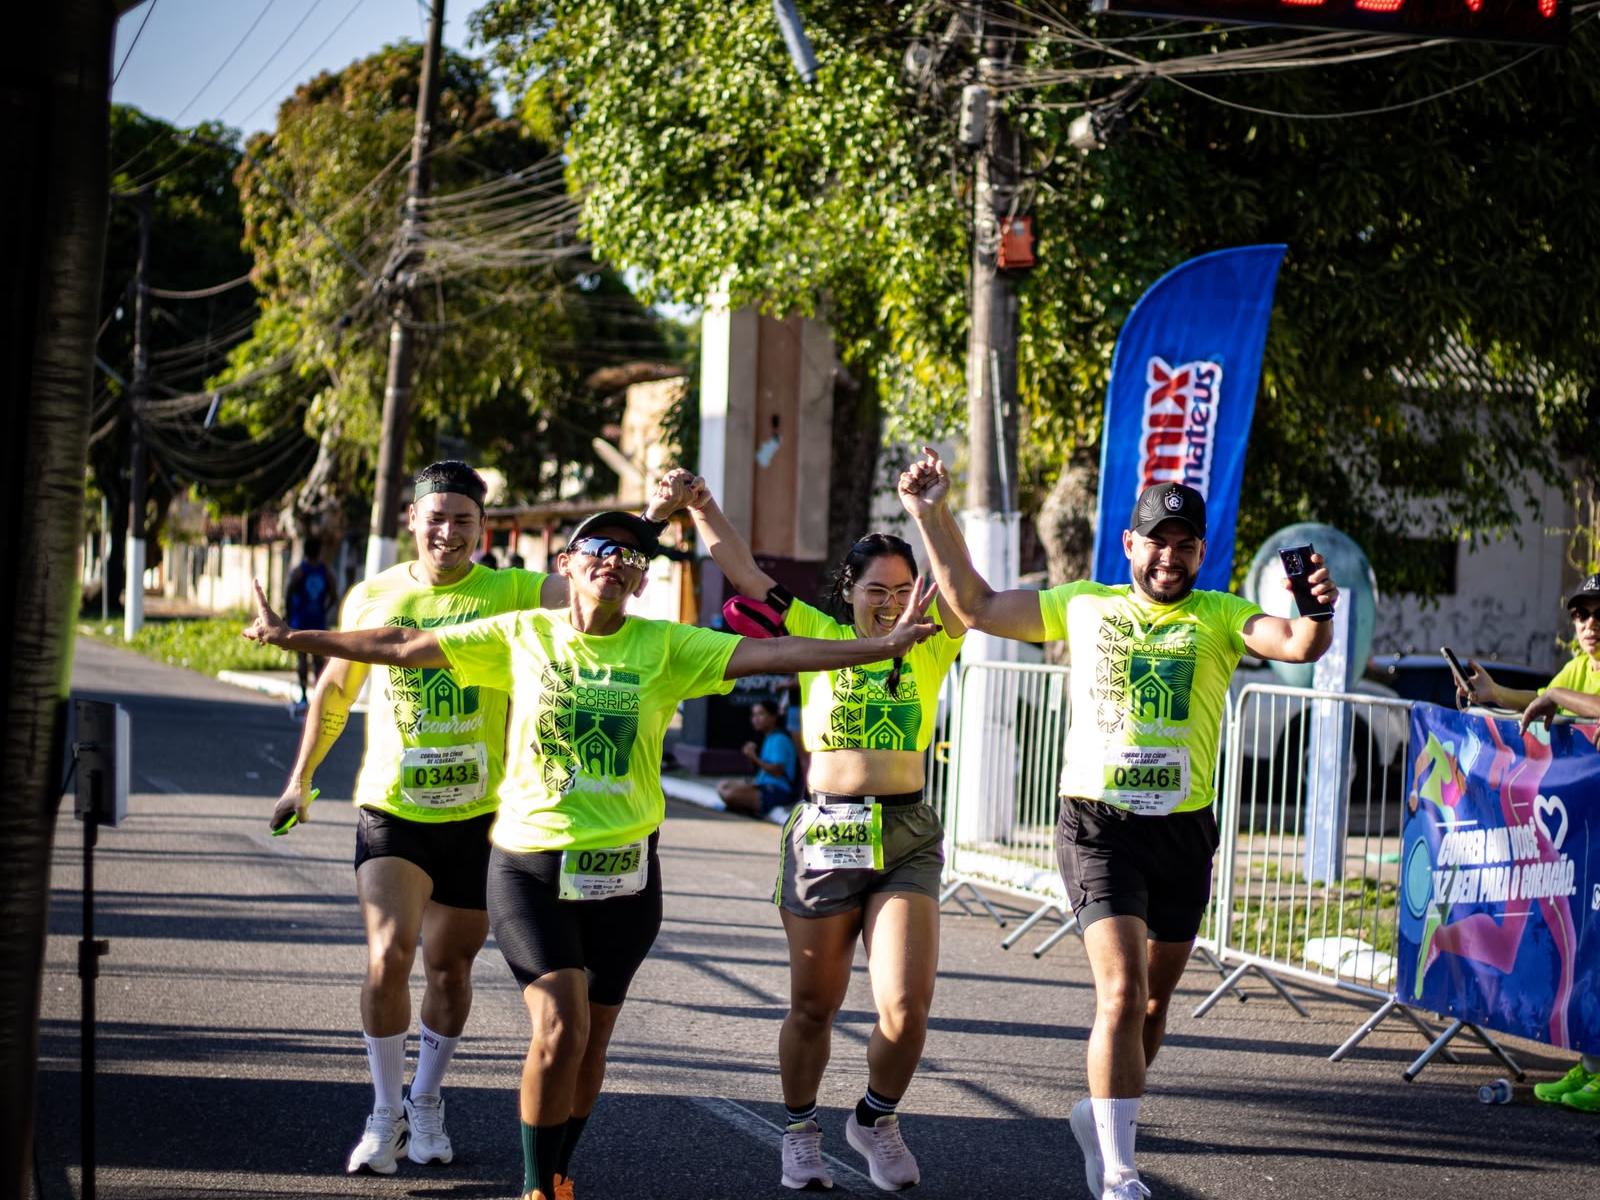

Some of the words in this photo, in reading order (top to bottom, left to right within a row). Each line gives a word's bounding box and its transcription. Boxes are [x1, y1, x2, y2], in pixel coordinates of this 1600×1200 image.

[1142, 361, 1191, 490] mix
[576, 695, 640, 711] CORRIDA
[577, 686, 641, 702] CORRIDA
[415, 765, 469, 787] 0343
[1113, 767, 1170, 788] 0346
[815, 822, 869, 843] 0348
[1437, 829, 1486, 865] CORRER
[1485, 827, 1511, 864] COM
[1509, 816, 1541, 861] VOCÊ
[578, 850, 632, 872] 0275
[1447, 868, 1481, 904] BEM
[1478, 865, 1511, 902] PARA
[1510, 864, 1521, 901] O
[1520, 853, 1577, 906] CORAÇÃO.
